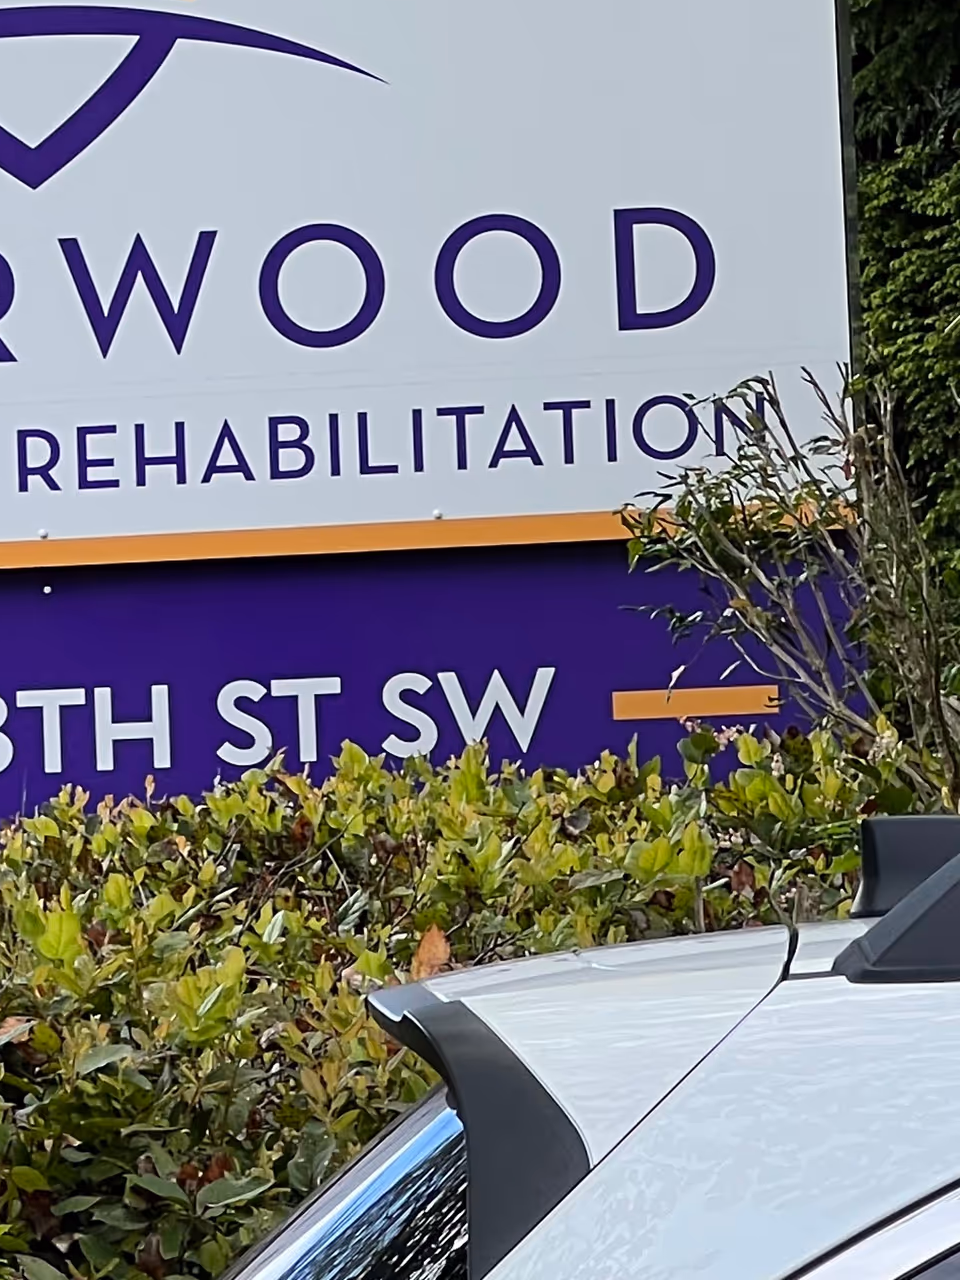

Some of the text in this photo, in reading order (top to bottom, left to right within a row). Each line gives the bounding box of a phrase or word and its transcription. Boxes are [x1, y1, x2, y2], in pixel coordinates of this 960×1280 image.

[16, 391, 767, 494] REHABILITATION
[216, 676, 342, 767] ST
[381, 666, 557, 759] SW
